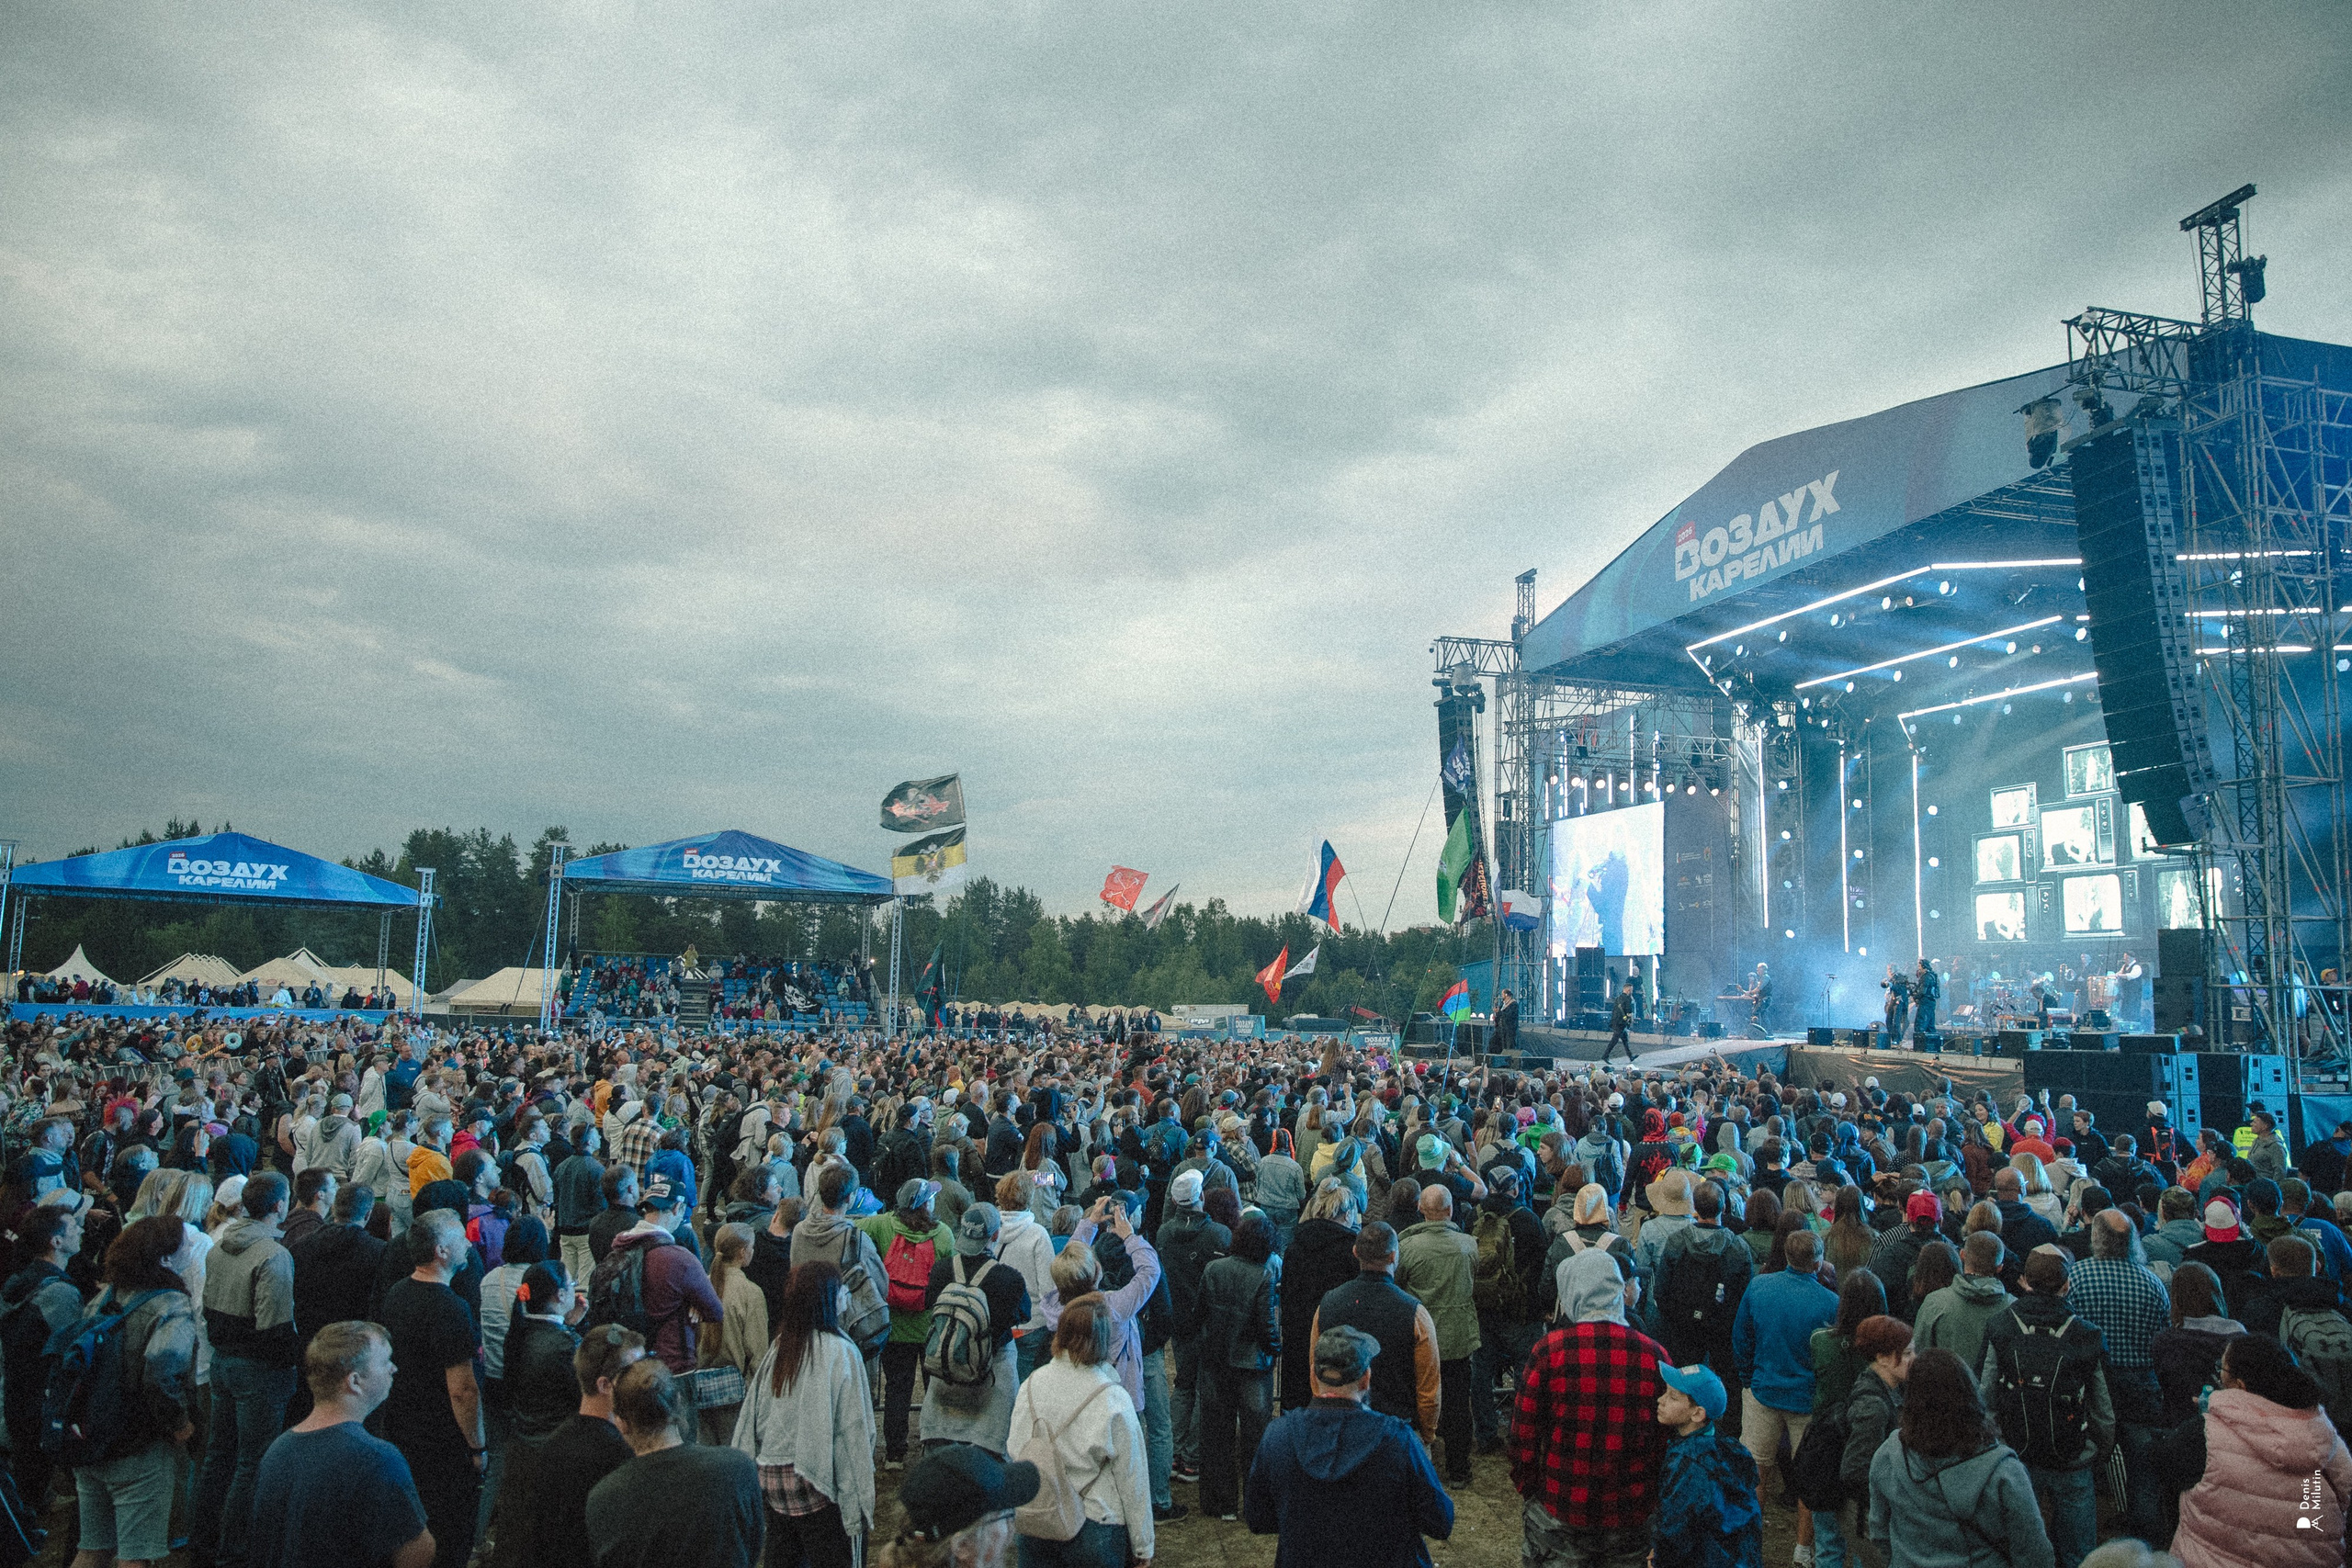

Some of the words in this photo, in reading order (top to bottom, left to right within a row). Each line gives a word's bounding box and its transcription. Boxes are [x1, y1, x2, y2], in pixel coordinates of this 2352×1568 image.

[1675, 469, 1840, 581] ВОЗДУХ
[1690, 524, 1824, 602] КАРЕЛИИ
[167, 858, 289, 880] ВОЗДУХ
[683, 854, 782, 874] ВОЗДУХ
[178, 875, 277, 889] КАРЕЛИИ
[692, 869, 772, 882] КАРЕЛИИ
